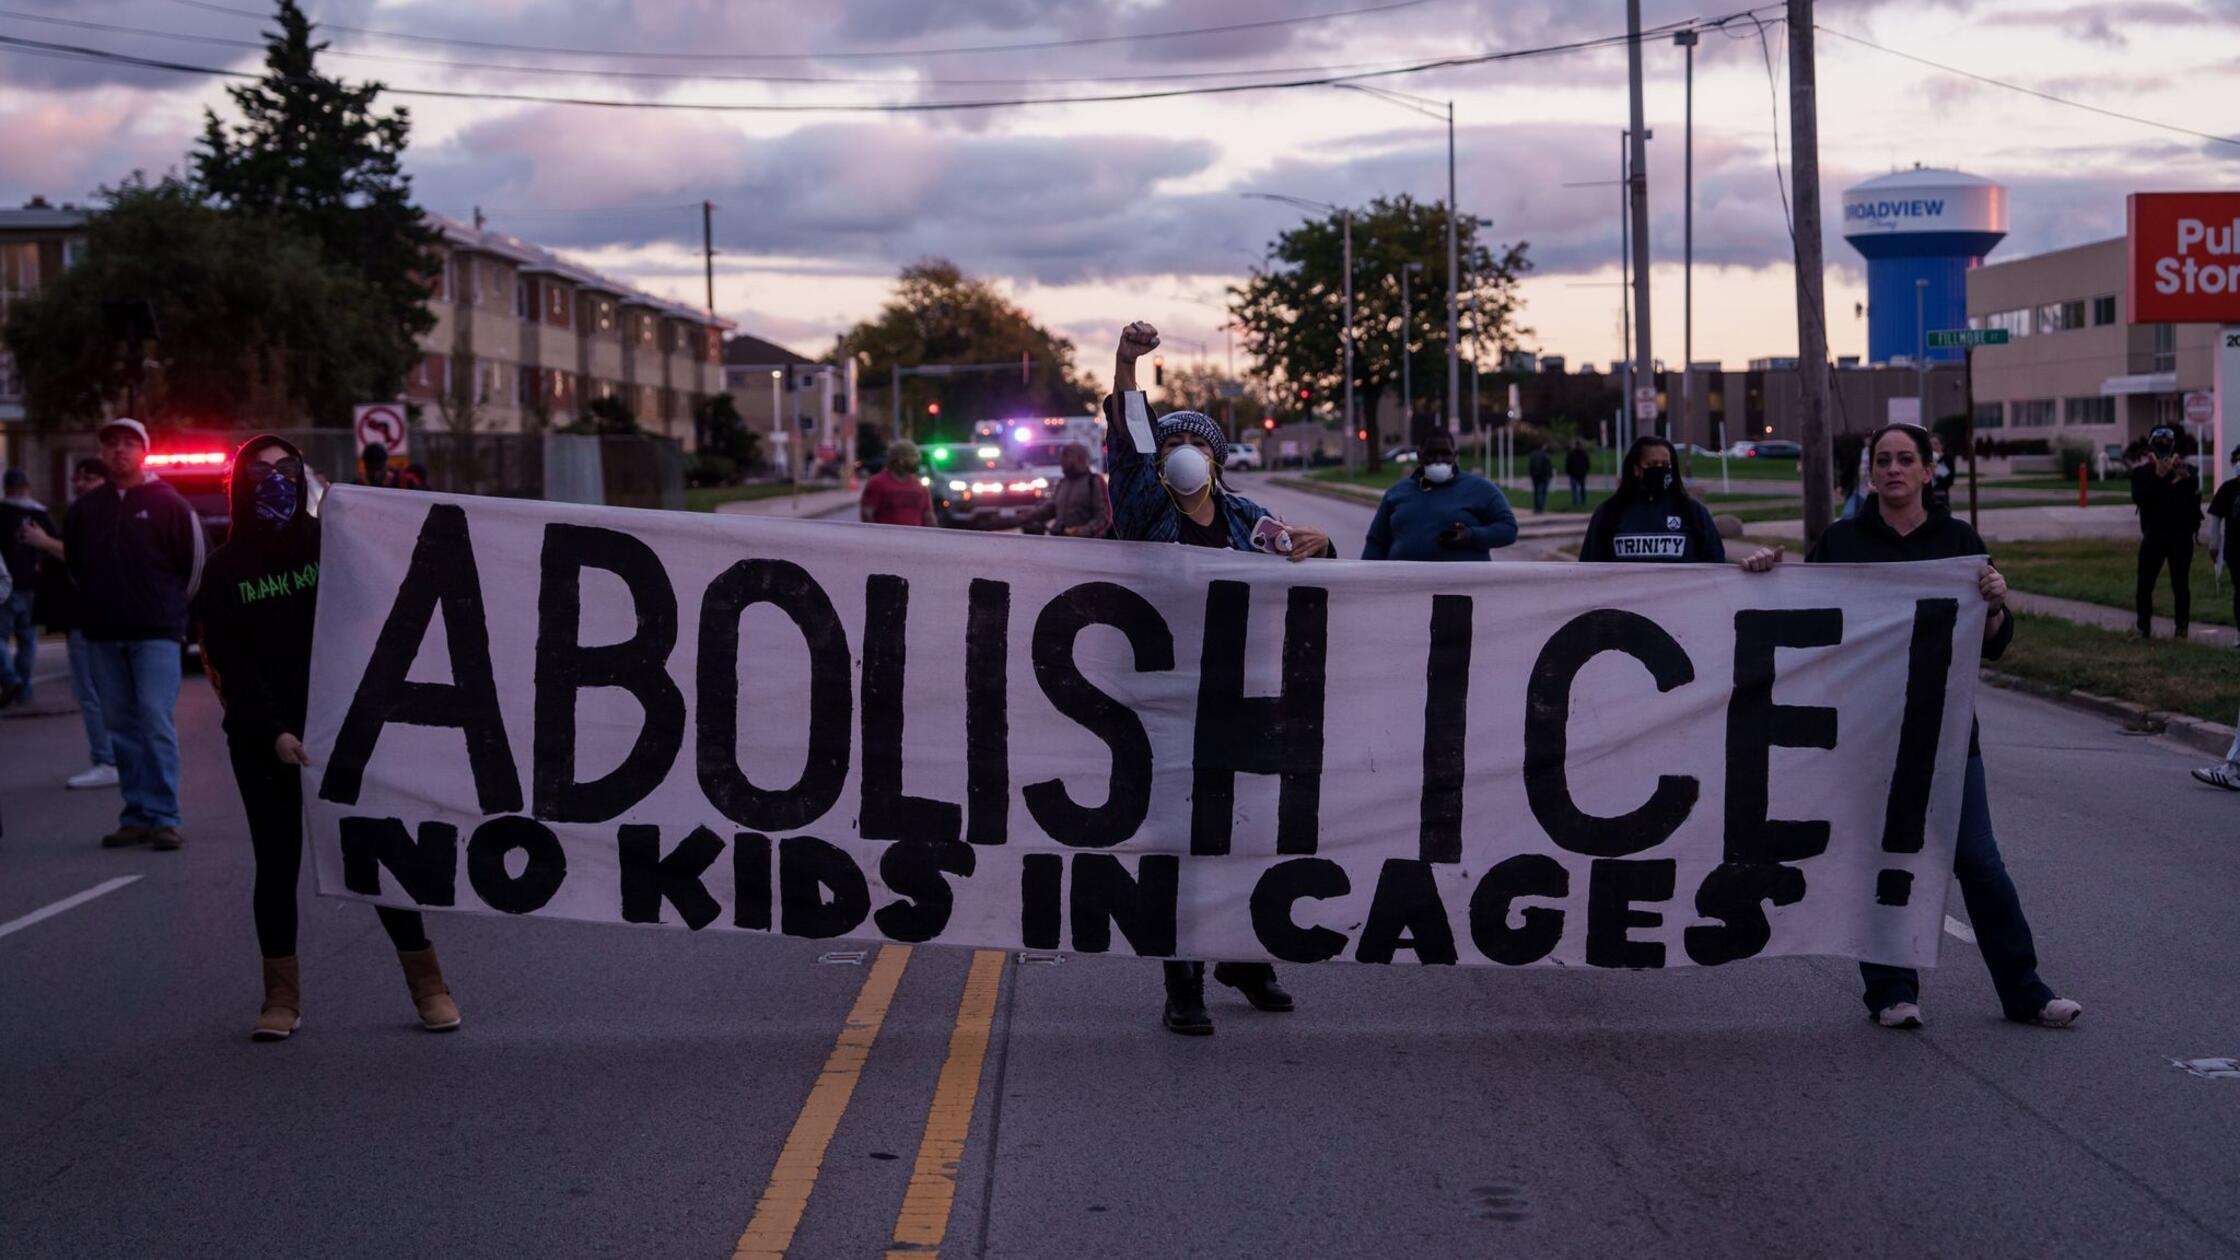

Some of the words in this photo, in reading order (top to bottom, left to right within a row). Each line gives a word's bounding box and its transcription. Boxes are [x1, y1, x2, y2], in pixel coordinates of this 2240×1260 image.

[1938, 330, 1984, 346] FILLMORE
[1615, 538, 1683, 555] TRINITY
[319, 504, 1328, 855] ABOLISH
[339, 816, 567, 914] NO
[617, 824, 976, 943] KIDS
[1021, 852, 1180, 957] IN
[1249, 853, 1806, 969] CAGES
